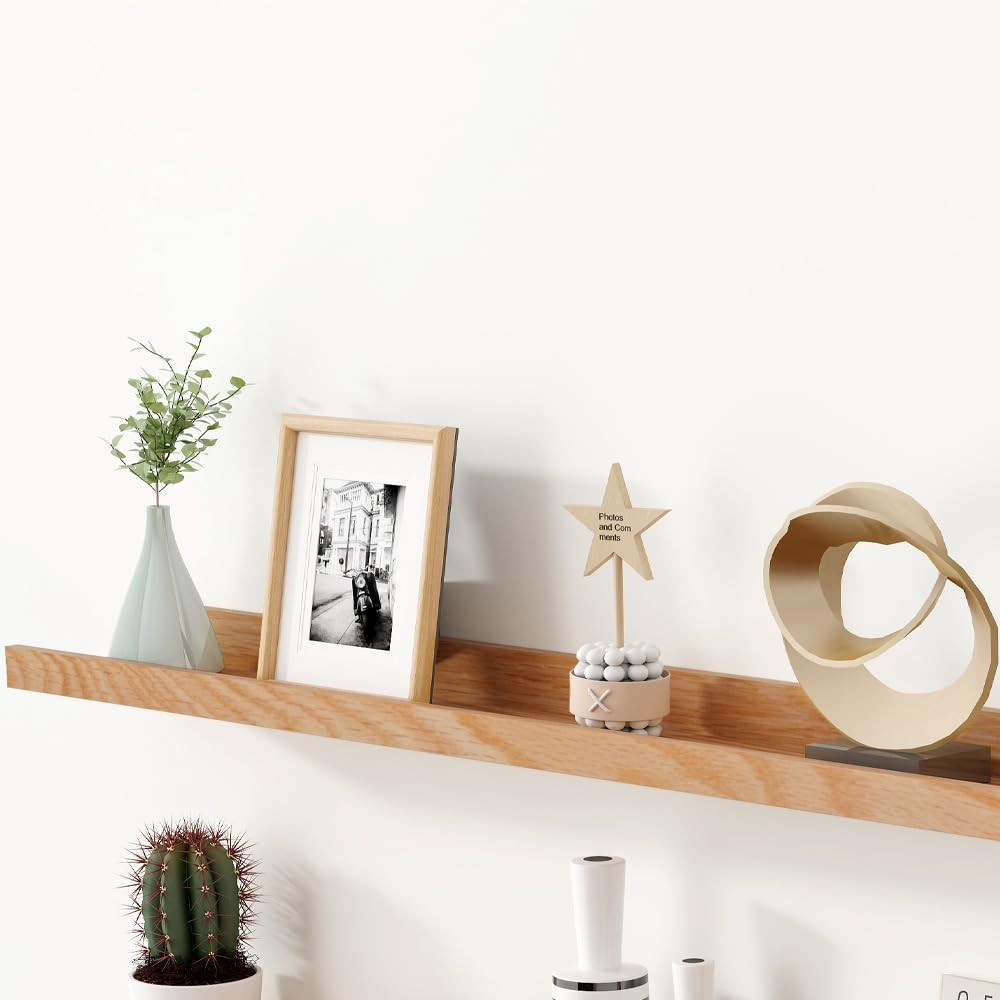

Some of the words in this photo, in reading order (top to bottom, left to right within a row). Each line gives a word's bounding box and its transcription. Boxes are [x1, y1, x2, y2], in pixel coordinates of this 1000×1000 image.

[598, 512, 624, 521] Photos
[598, 523, 613, 531] and
[614, 523, 632, 532] Com
[599, 534, 621, 542] ments
